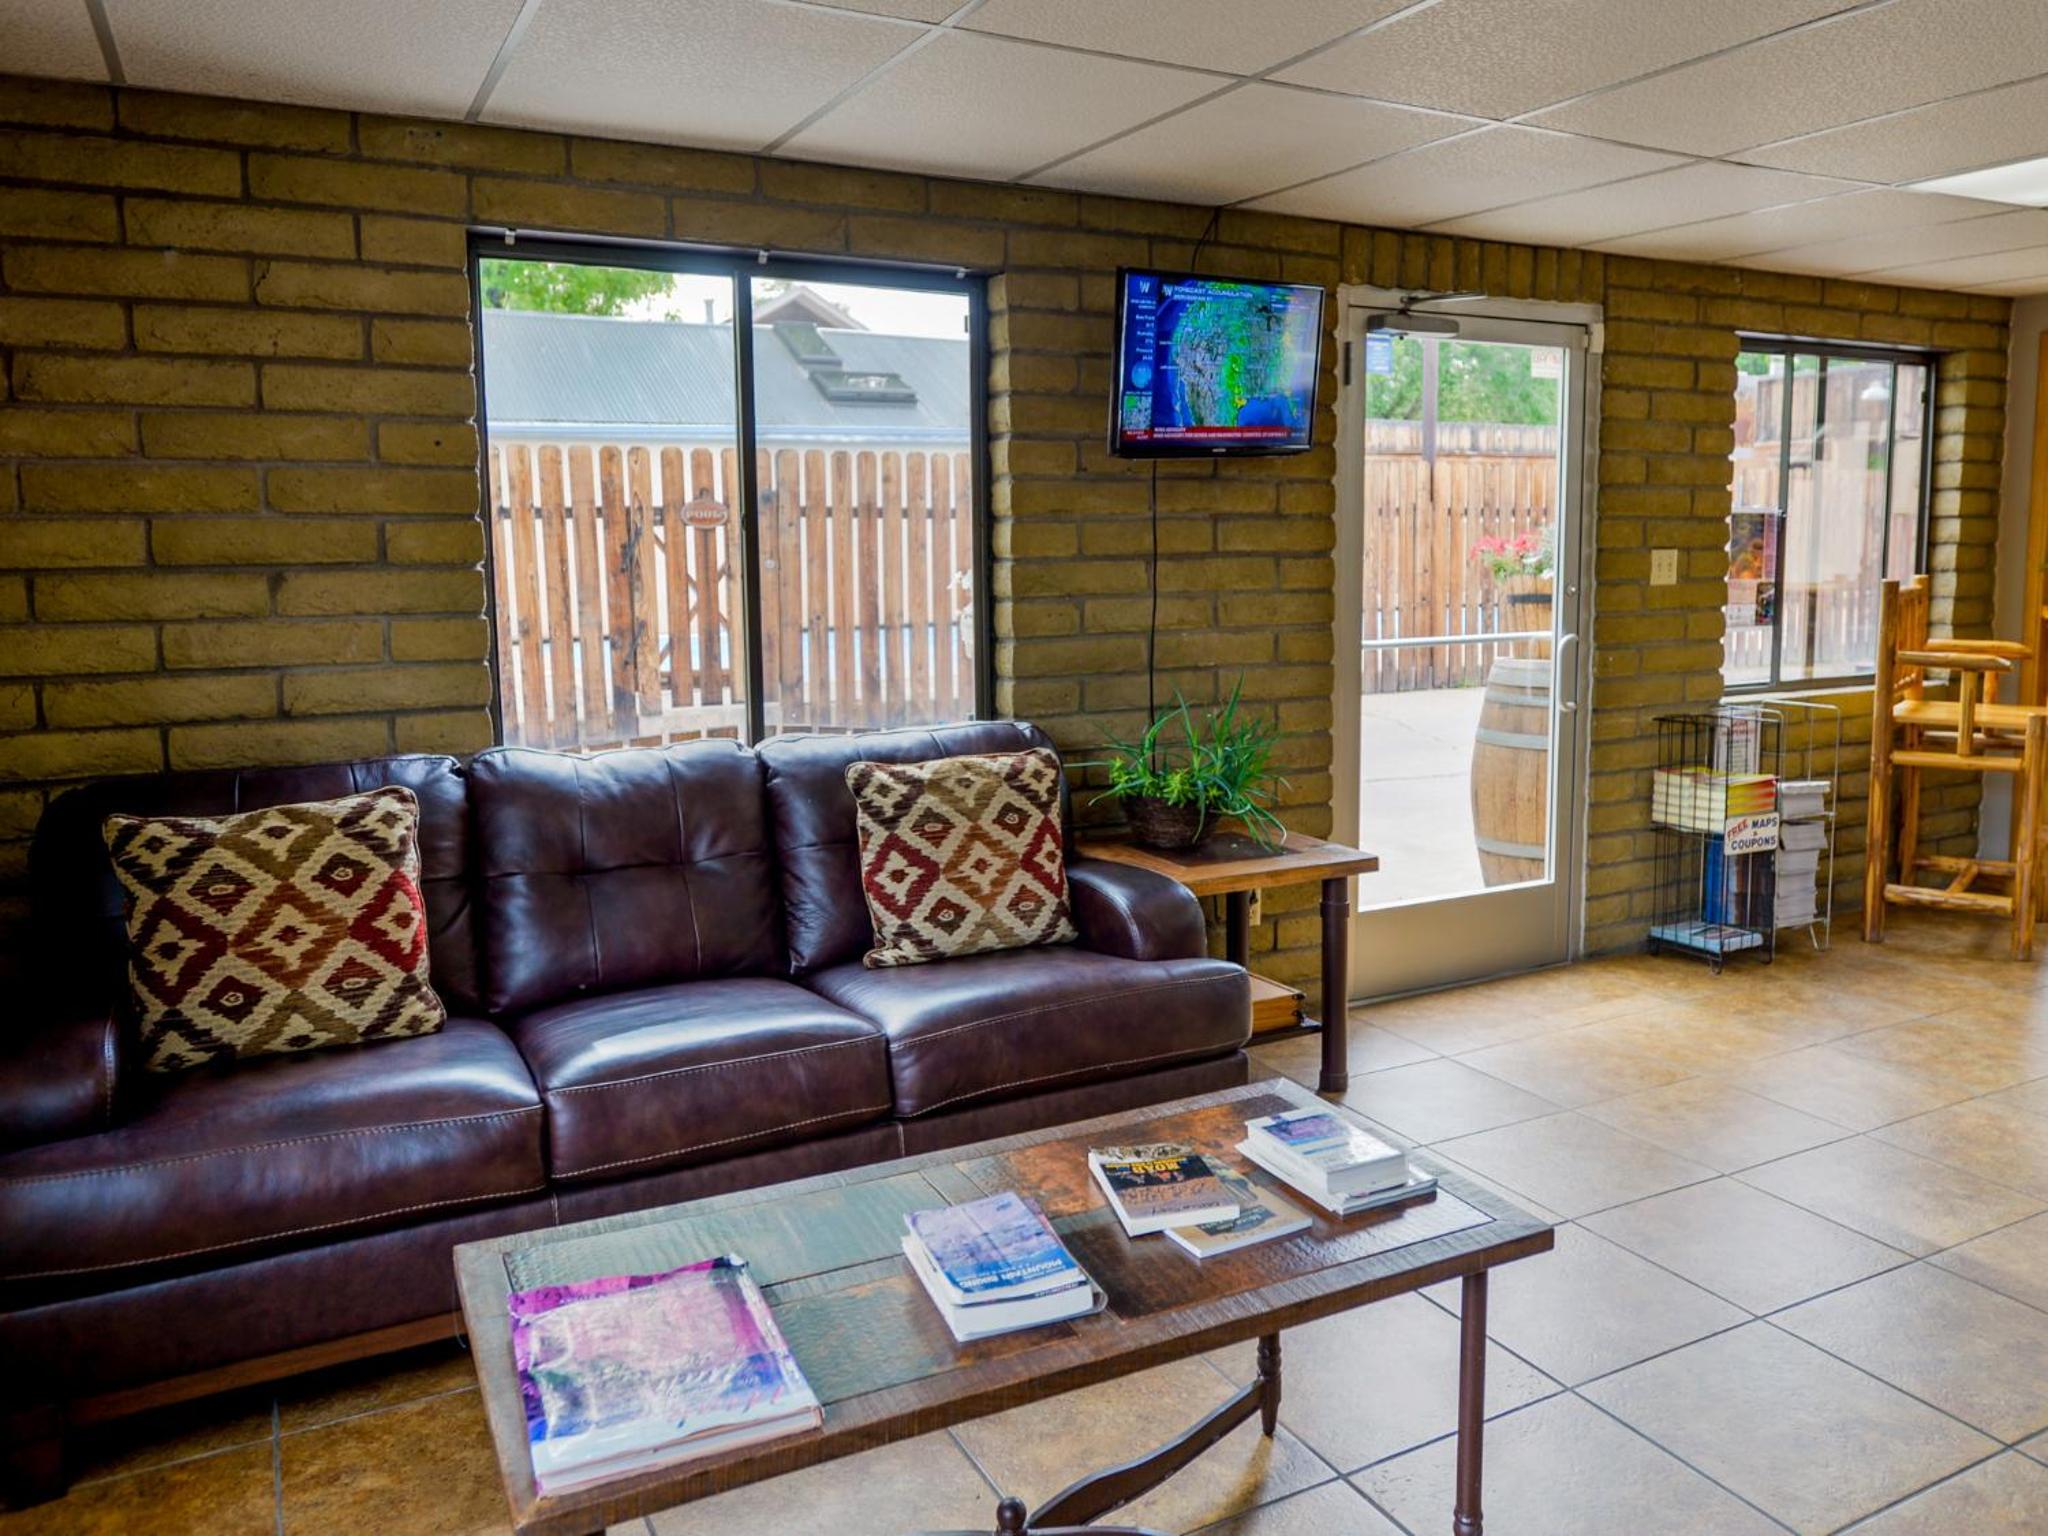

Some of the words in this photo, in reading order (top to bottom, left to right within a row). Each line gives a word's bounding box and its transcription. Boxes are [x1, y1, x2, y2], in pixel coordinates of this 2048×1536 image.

[1727, 819, 1748, 840] FREE
[1751, 817, 1778, 830] MAPS
[1731, 835, 1776, 850] COUPONS
